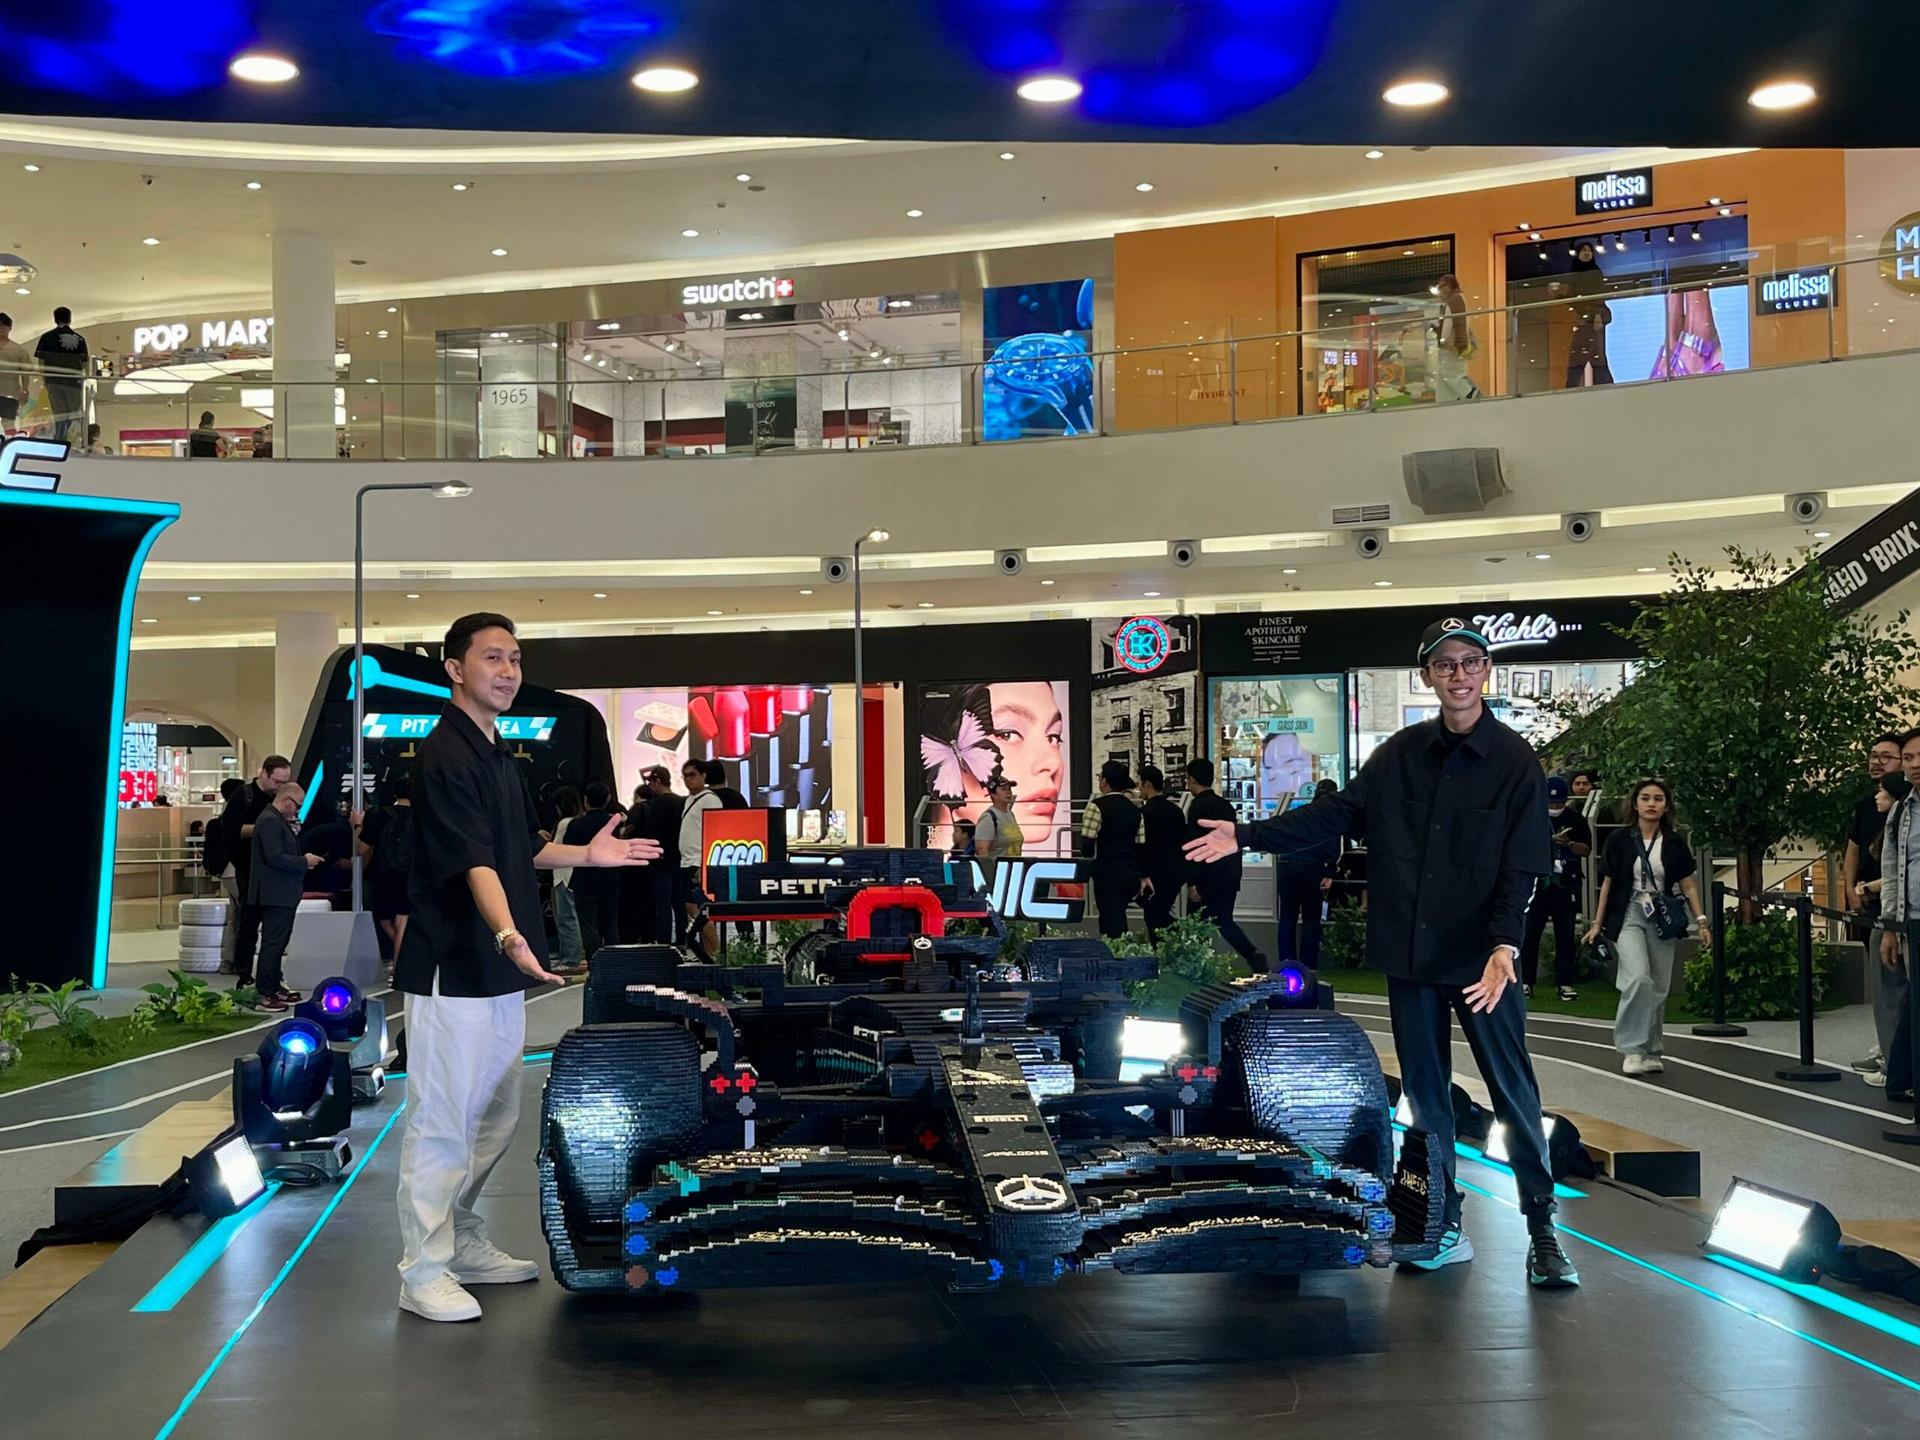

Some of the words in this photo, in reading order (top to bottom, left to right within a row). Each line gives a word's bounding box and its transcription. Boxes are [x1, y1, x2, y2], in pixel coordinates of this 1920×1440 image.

[1582, 174, 1647, 202] melissa
[682, 276, 777, 305] swatch
[1762, 273, 1830, 302] melissa
[133, 323, 189, 353] POP
[201, 317, 274, 348] MAR
[492, 389, 528, 406] 1965
[747, 400, 776, 409] satch
[1244, 625, 1308, 636] APOTHECARY
[1259, 616, 1294, 626] FINEST
[1472, 612, 1558, 644] Kiehl's
[1251, 635, 1301, 645] SKINCARE
[400, 718, 429, 733] PIT
[969, 860, 1077, 919] NIC
